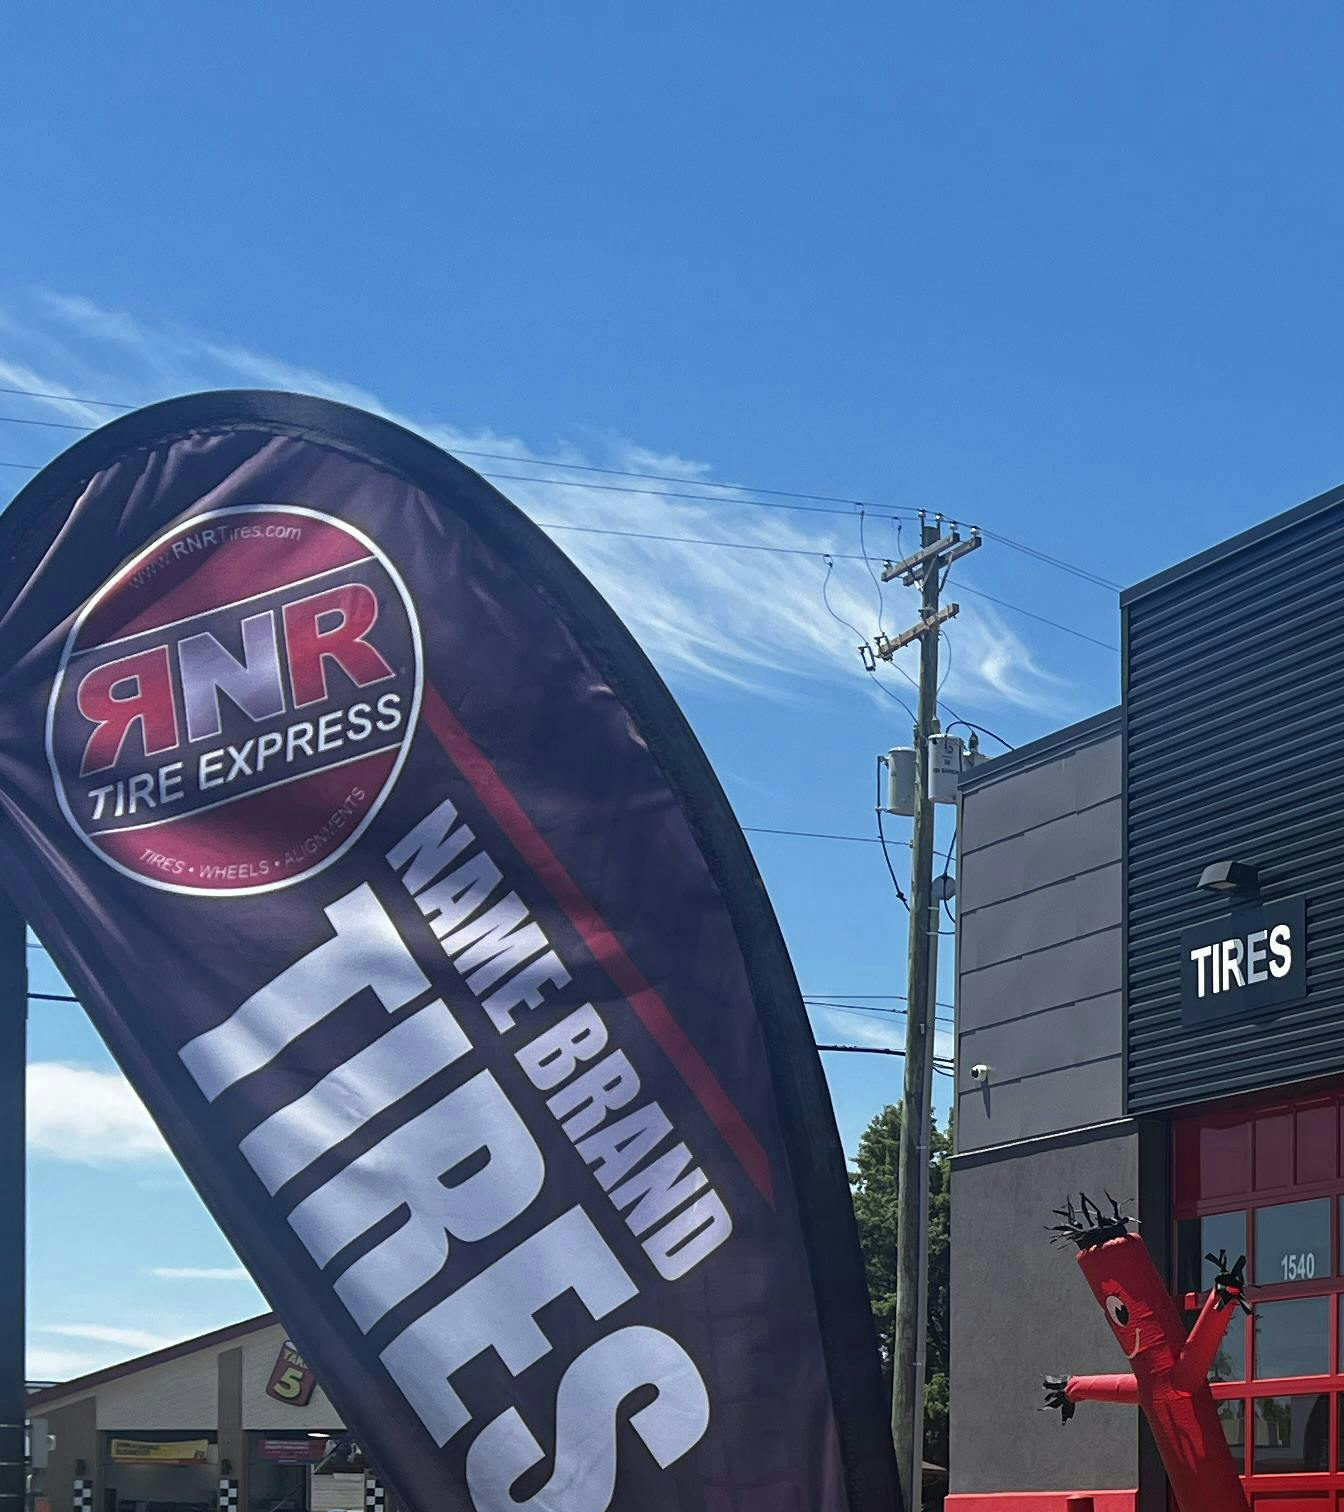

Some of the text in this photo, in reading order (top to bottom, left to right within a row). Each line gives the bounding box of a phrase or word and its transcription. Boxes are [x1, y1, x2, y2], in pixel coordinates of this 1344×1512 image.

[77, 582, 396, 778] RNR
[88, 693, 402, 820] TIRE EXPRESS
[140, 786, 367, 880] TIRES WHEELS ALIGNMENTS
[1190, 924, 1292, 999] TIRES
[386, 798, 734, 1282] NAME BRAND
[1281, 1252, 1315, 1281] 1540
[273, 1367, 304, 1399] 5
[282, 1350, 310, 1370] TAK
